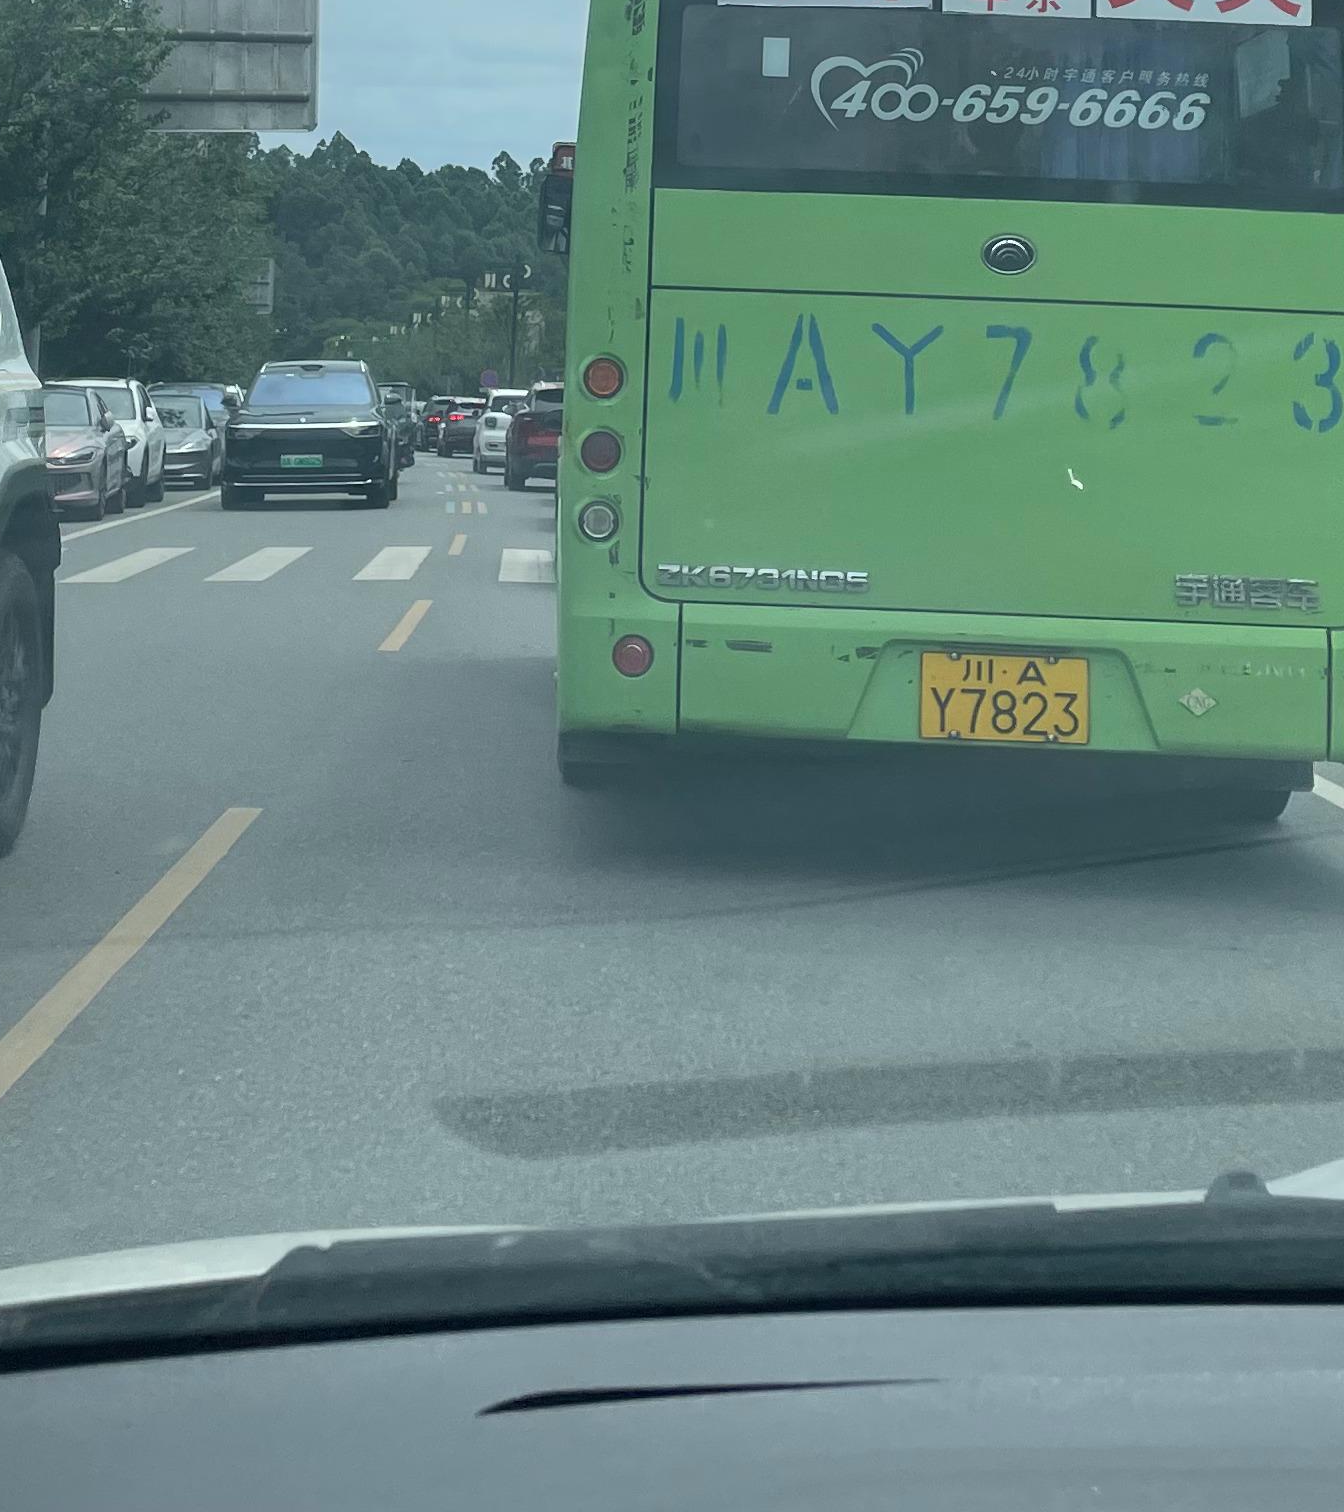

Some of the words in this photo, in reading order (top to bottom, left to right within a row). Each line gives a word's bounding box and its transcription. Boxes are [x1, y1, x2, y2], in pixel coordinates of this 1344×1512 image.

[830, 79, 1211, 131] 400-659-6666
[1175, 573, 1319, 610] 宇通客车
[930, 687, 1080, 737] Y7823
